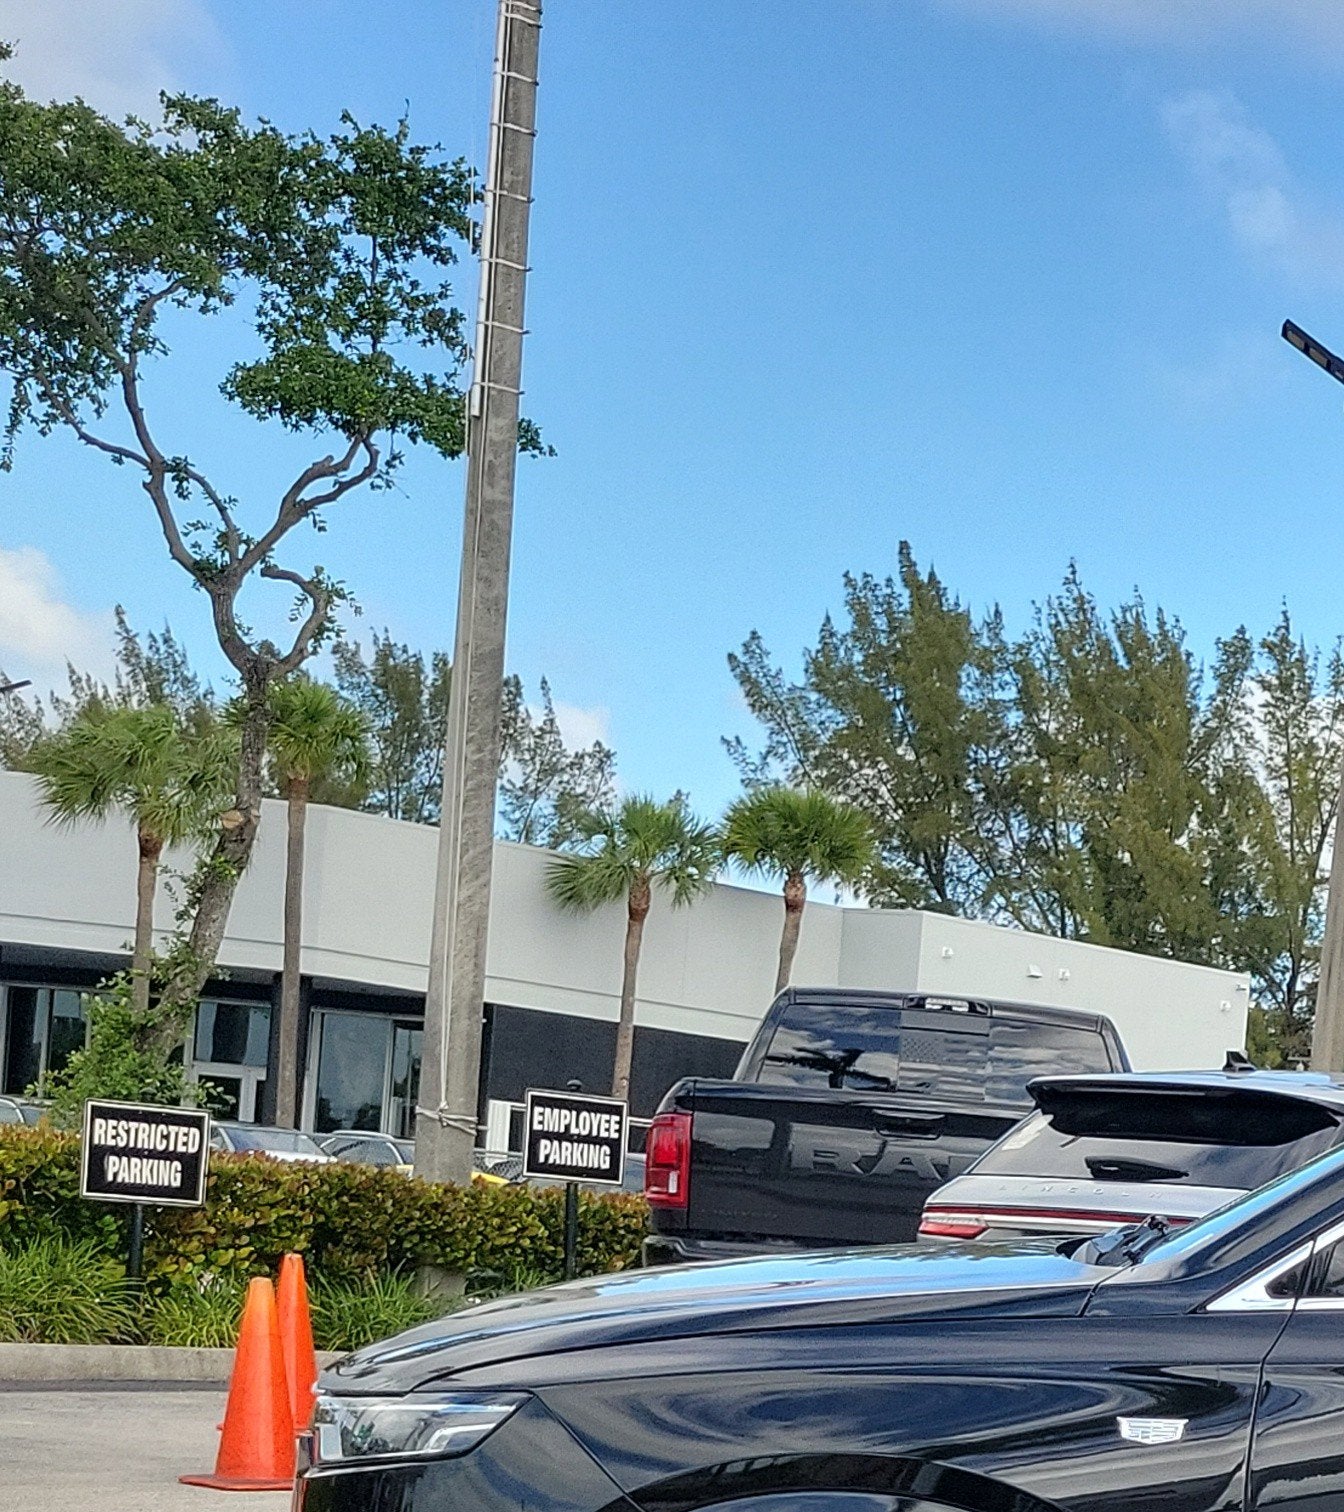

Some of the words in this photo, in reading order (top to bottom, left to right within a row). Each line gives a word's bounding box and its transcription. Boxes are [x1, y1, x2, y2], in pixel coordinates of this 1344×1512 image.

[93, 1119, 202, 1155] RESTRICTED
[532, 1106, 621, 1138] EMPLOYEE
[538, 1138, 611, 1170] PARKING
[107, 1156, 183, 1188] PARKING
[998, 1183, 1164, 1200] LINCOLN
